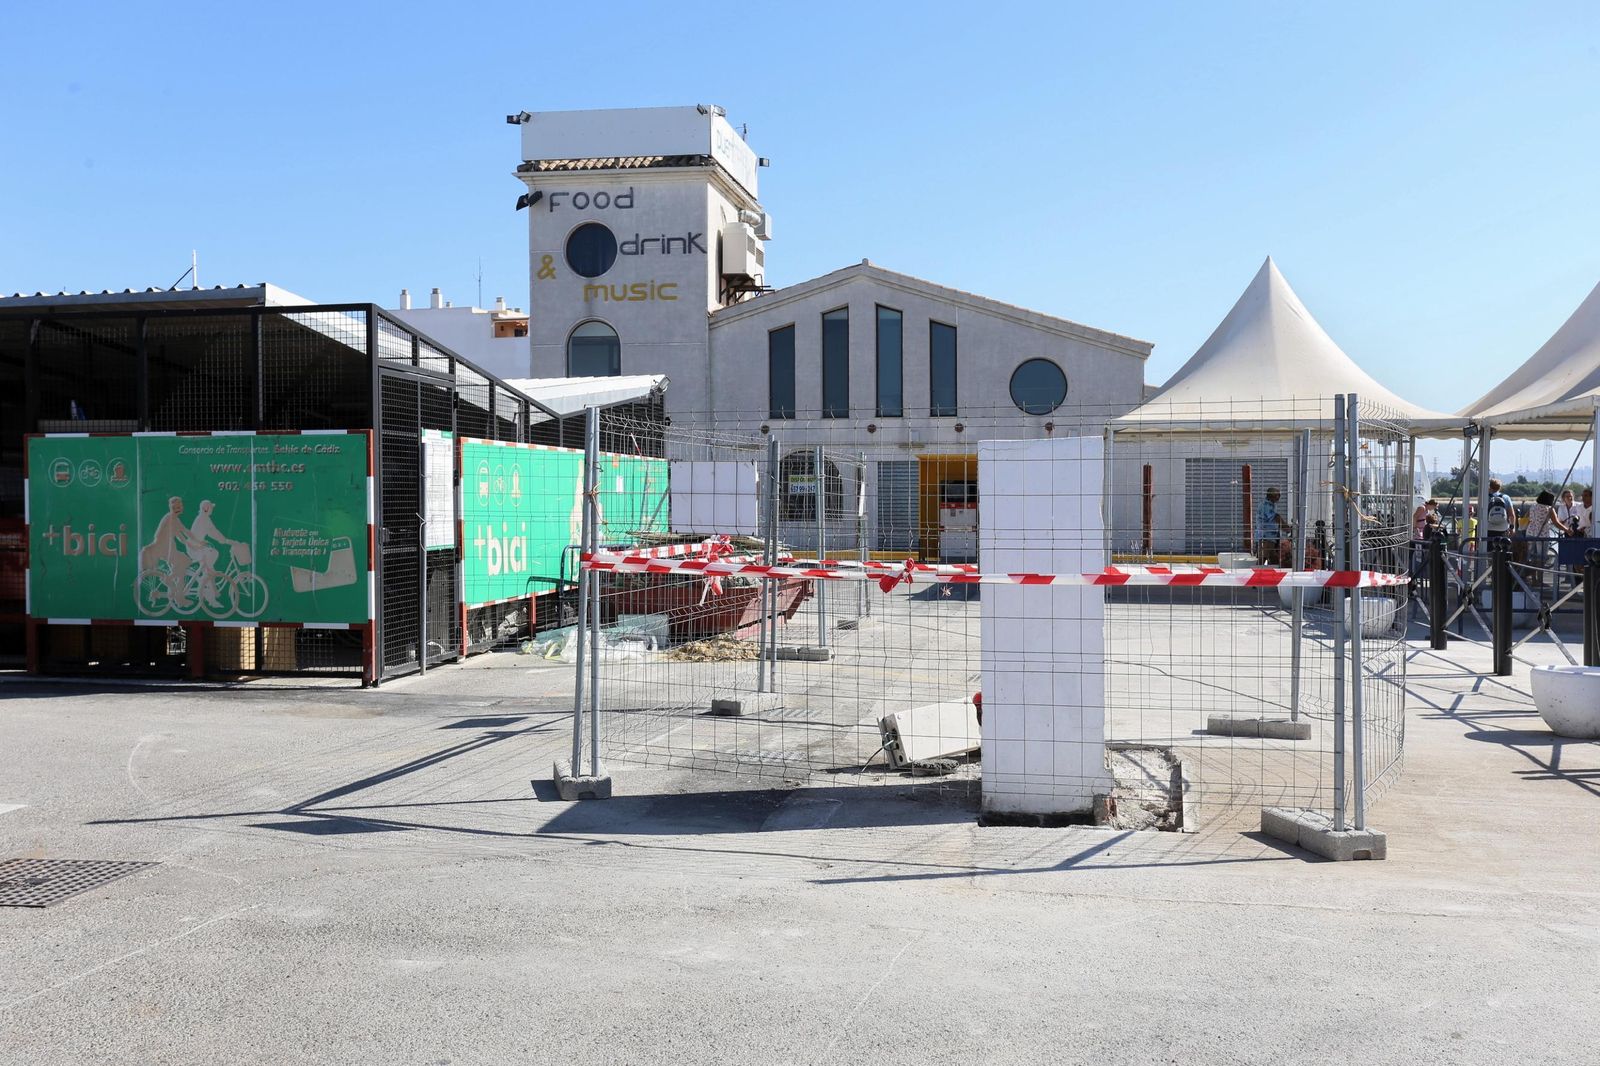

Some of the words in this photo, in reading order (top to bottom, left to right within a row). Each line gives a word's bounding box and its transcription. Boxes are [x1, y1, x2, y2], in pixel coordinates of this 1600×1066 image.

[549, 186, 634, 213] Food
[537, 254, 557, 280] &
[583, 280, 678, 303] music
[178, 444, 214, 455] Consorcio
[216, 445, 225, 454] de
[301, 445, 311, 454] de
[217, 481, 240, 492] 902
[271, 481, 294, 492] 550
